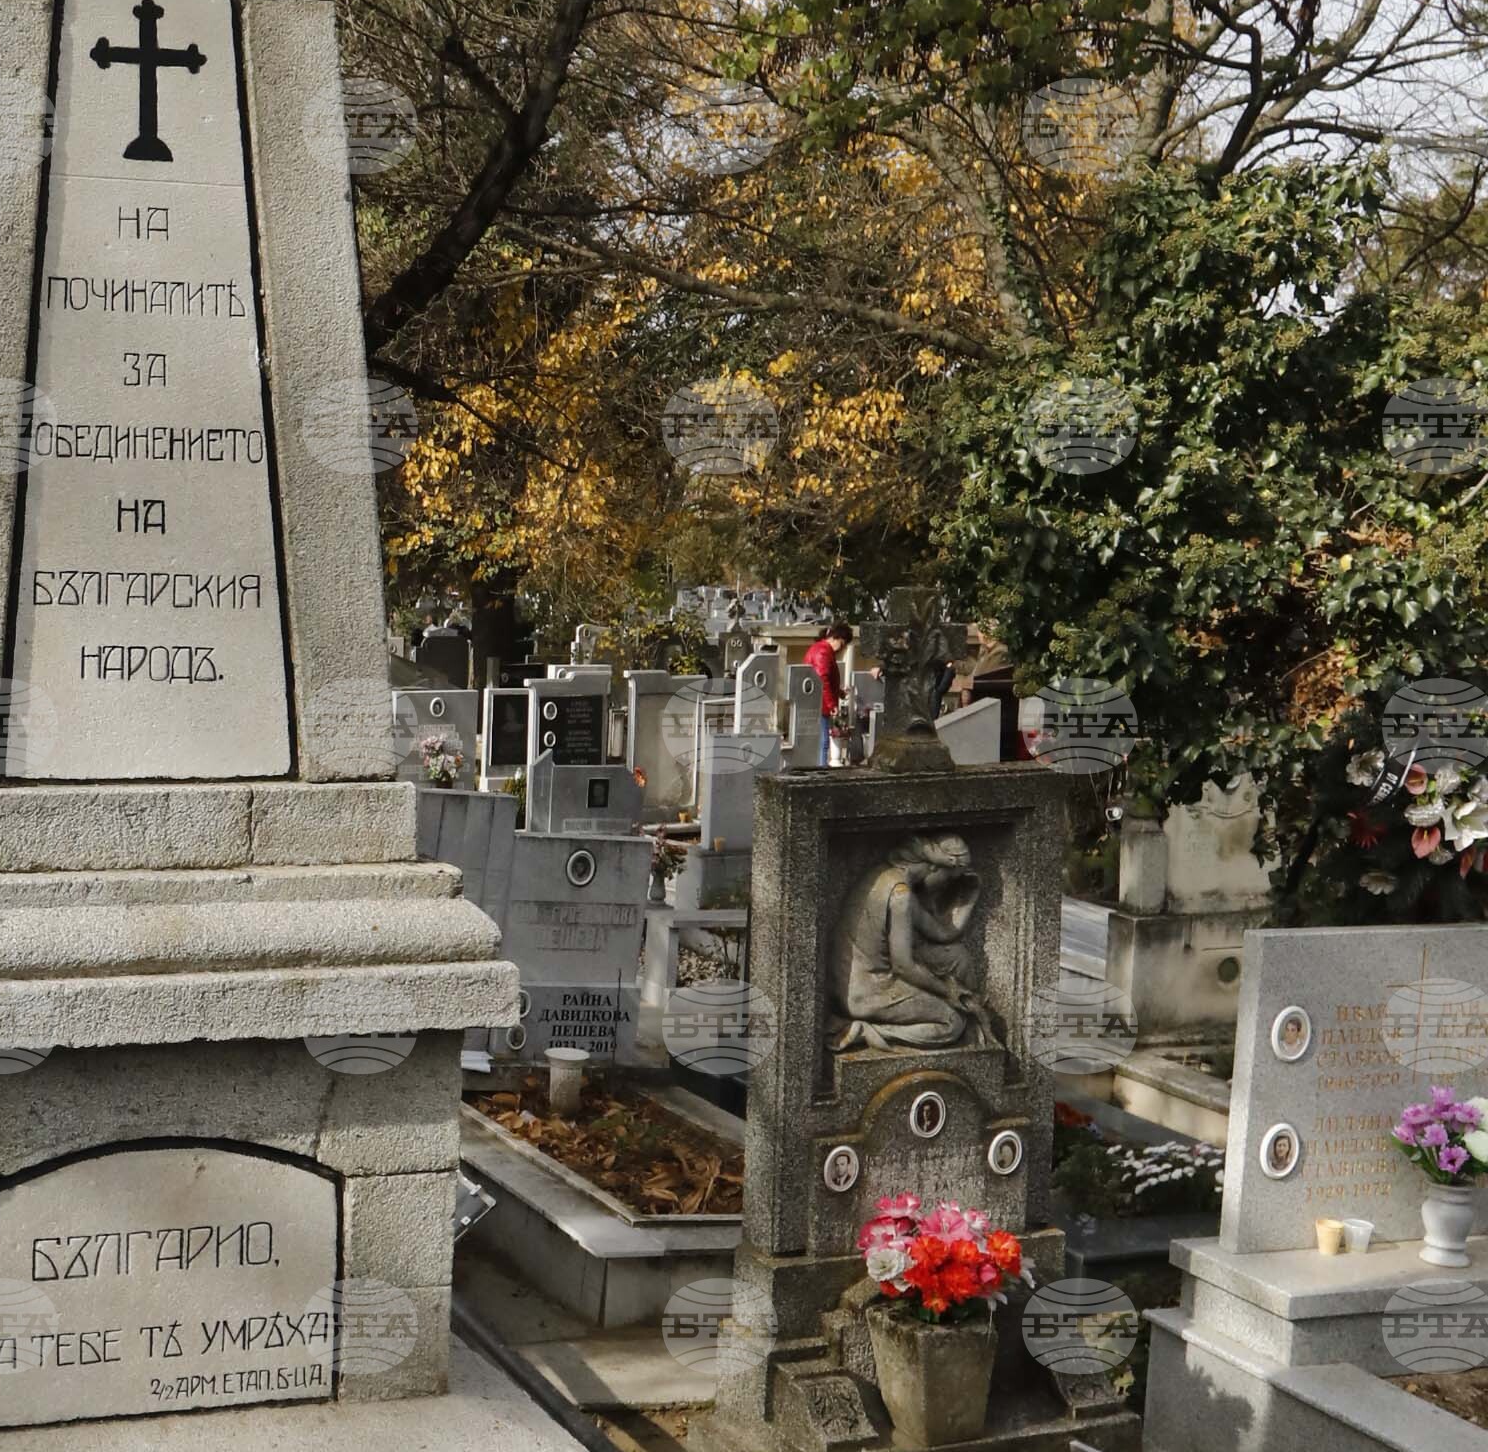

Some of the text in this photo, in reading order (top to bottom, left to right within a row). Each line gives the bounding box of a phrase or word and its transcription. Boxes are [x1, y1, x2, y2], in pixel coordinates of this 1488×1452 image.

[118, 206, 169, 241] НА
[124, 353, 167, 387] ЗА
[34, 422, 263, 464] ОБЕДИНЕНИЕТО
[118, 499, 166, 535] НА
[33, 571, 261, 609] БЪЛГАРСКИЯ
[538, 1009, 631, 1023] ДАВИДКОВА
[562, 992, 612, 1007] РАЙНА
[552, 1024, 616, 1038] ПЕШЕВА
[31, 1329, 123, 1367] ТЕБЕ
